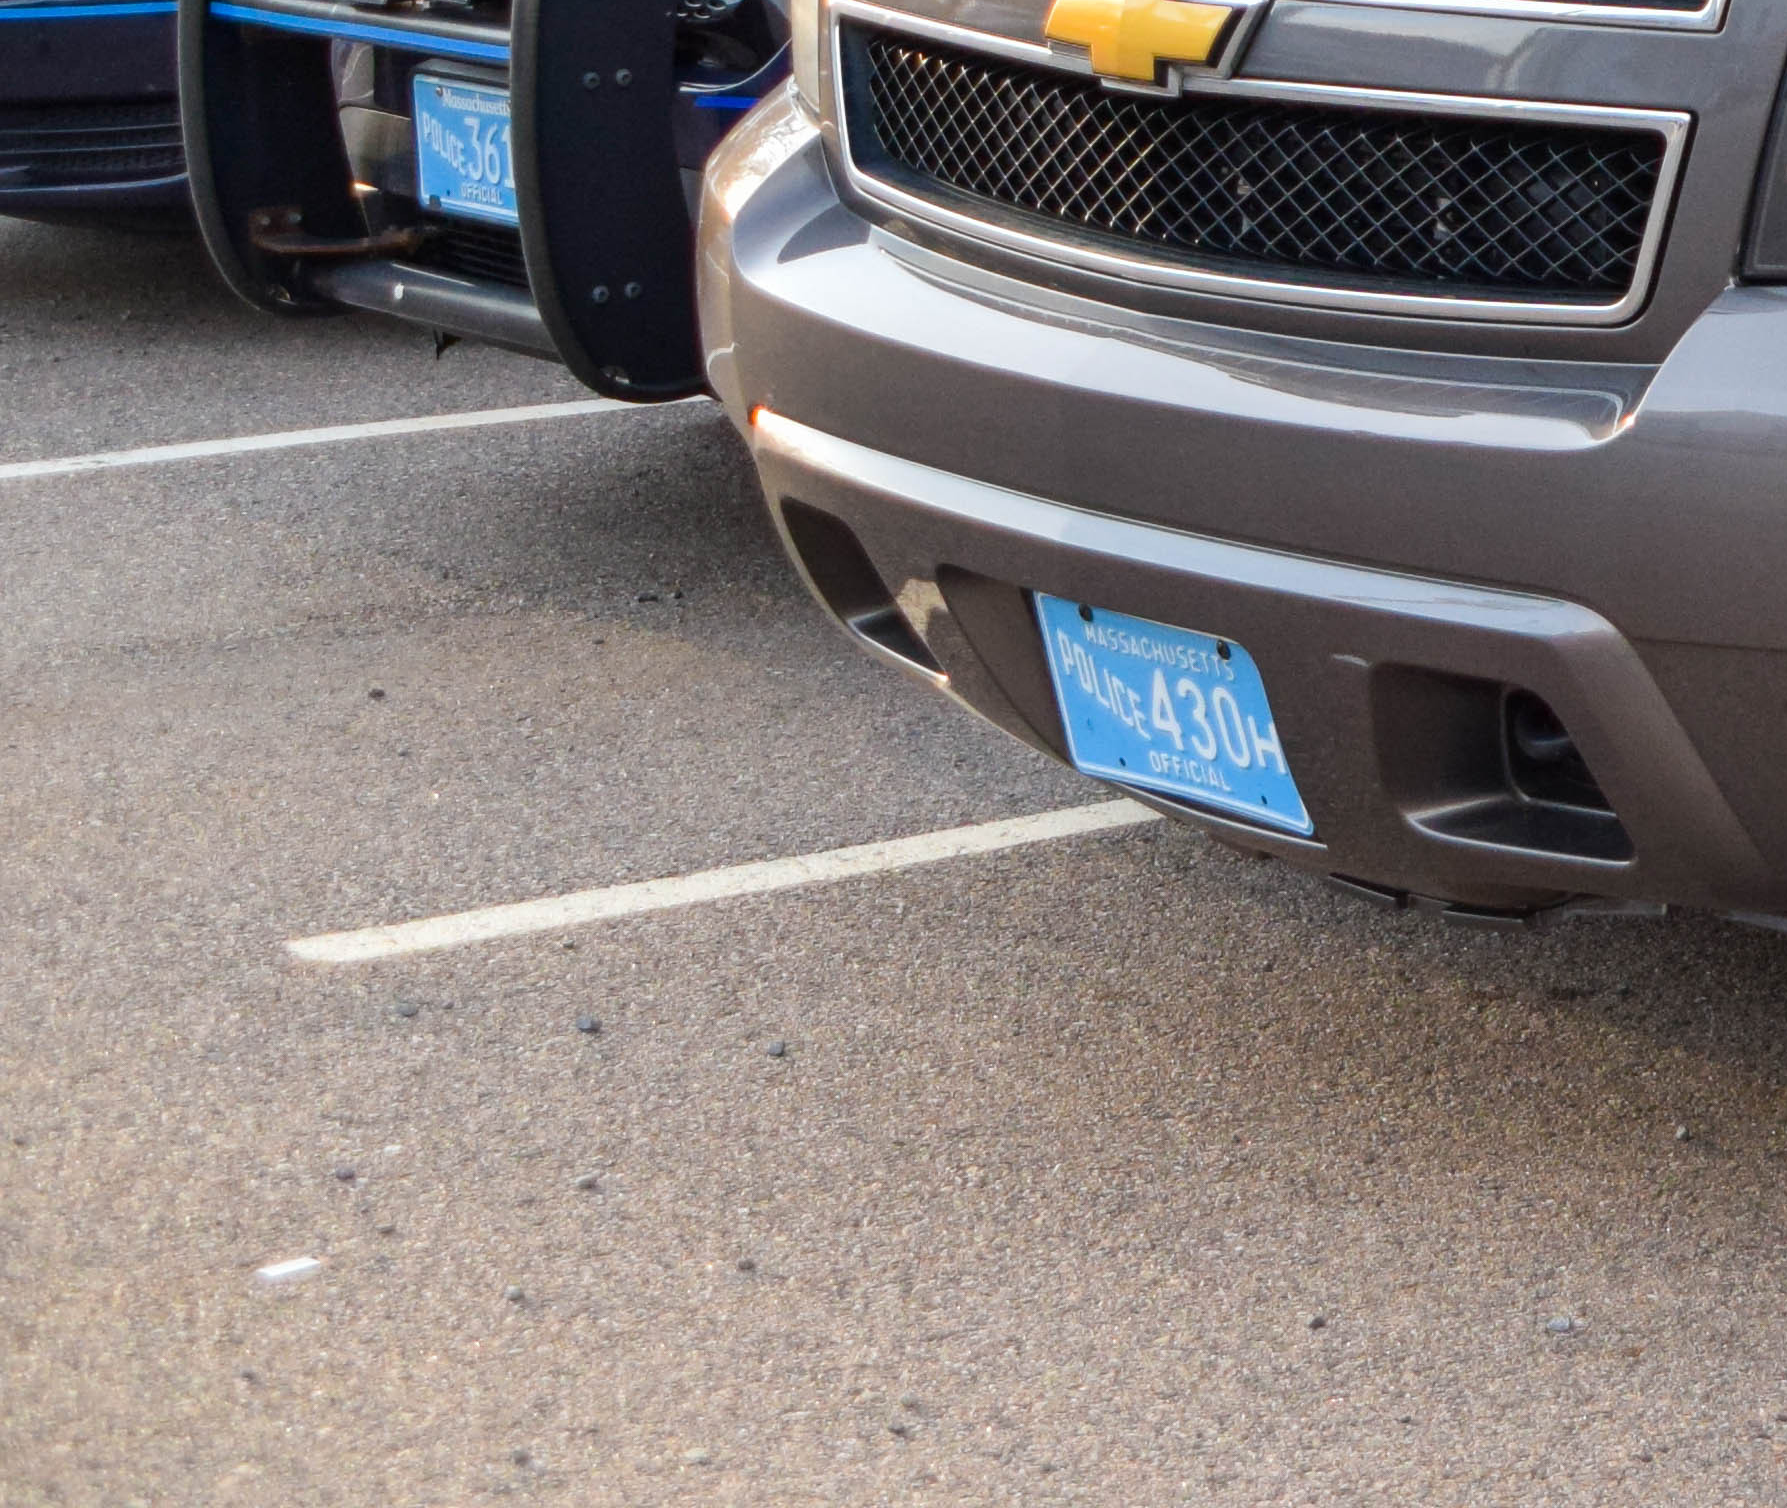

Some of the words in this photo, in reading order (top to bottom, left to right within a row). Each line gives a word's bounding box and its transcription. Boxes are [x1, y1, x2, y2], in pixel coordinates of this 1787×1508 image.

[422, 110, 467, 177] POLICE
[464, 116, 516, 190] 361
[461, 181, 504, 205] OFFICIAL
[1083, 622, 1236, 682] MASSACHUSETTS
[1057, 626, 1152, 741] POLICE
[1152, 666, 1288, 775] 430H
[1149, 750, 1232, 791] OFFICIAL
